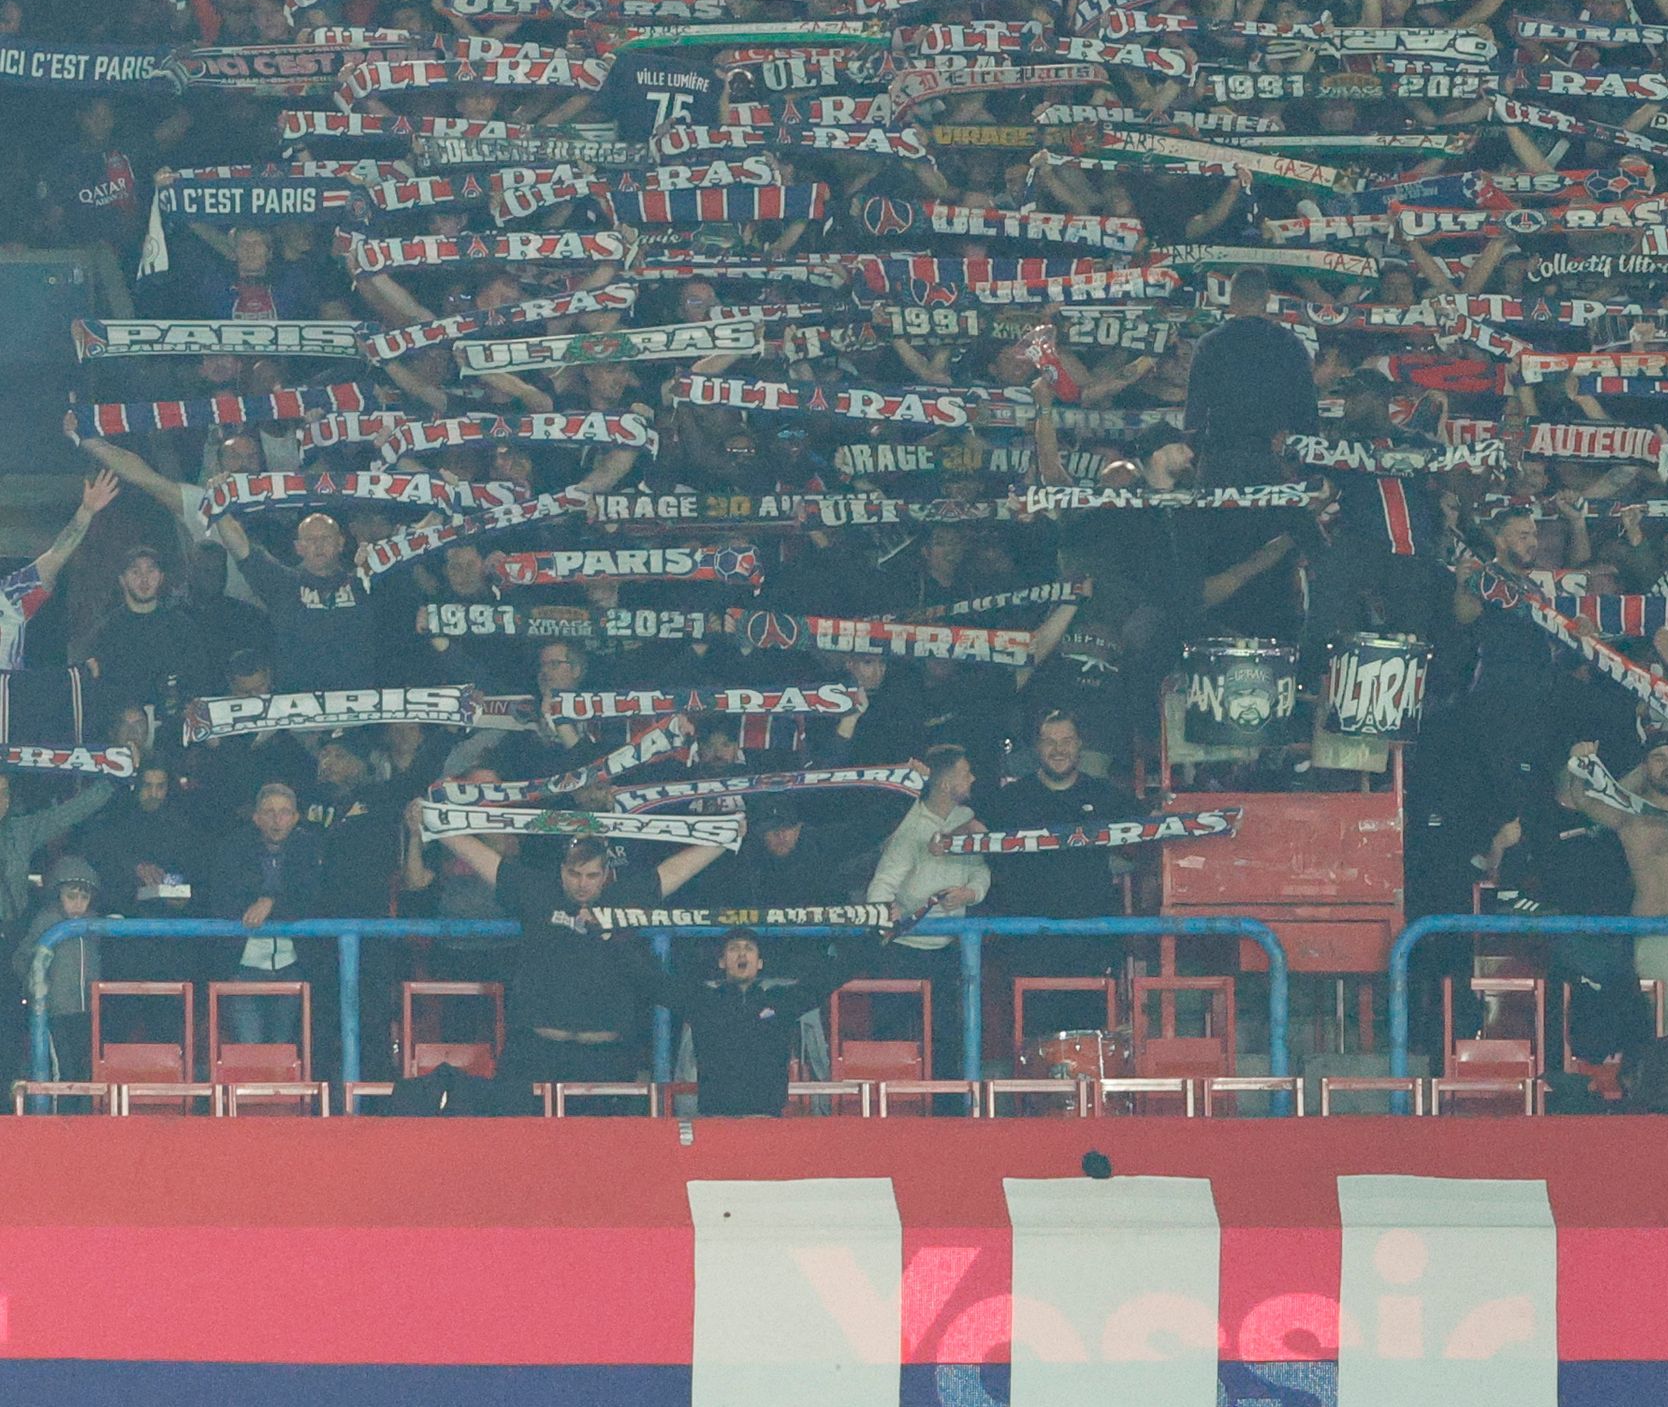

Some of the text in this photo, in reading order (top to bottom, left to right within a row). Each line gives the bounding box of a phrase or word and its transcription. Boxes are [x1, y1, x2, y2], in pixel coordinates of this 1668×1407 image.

[32, 51, 87, 78] C'EST
[95, 53, 154, 80] PARIS
[1212, 75, 1307, 101] 1991
[183, 188, 316, 213] C'EST PARIS
[105, 325, 359, 346] PARIS
[885, 307, 1172, 351] 1991 2021
[554, 551, 695, 575] PARIS
[428, 605, 706, 639] 1991 2021
[815, 620, 1035, 665] ULTRAS
[209, 688, 461, 720] PARIS
[591, 905, 893, 929] VIRAGE AUTEUIL
